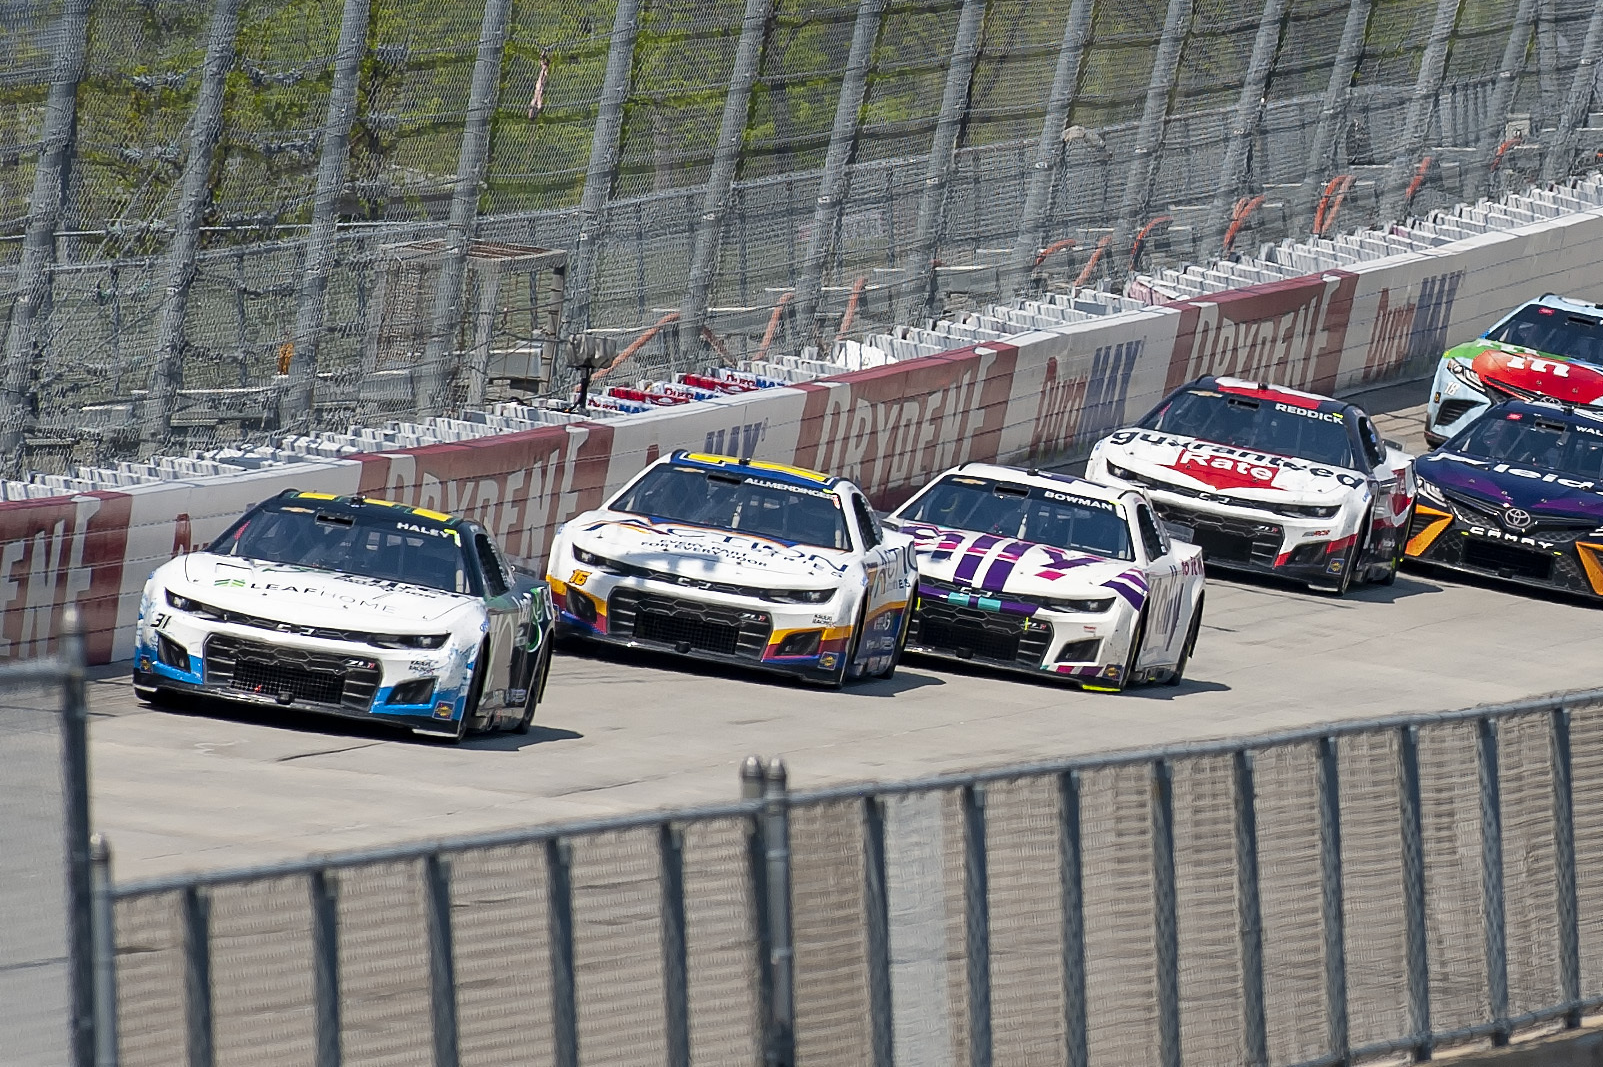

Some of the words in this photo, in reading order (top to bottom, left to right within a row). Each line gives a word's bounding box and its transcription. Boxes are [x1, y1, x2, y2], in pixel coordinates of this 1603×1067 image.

[1443, 381, 1461, 395] 18
[1275, 402, 1344, 425] REDDICK
[1109, 428, 1365, 490] guaranteed
[1181, 450, 1274, 481] Rate
[744, 477, 837, 501] ALLMENDINGER
[1044, 489, 1114, 511] BOWMAN
[396, 521, 450, 539] HALEY
[1469, 526, 1554, 550] CAMRY
[568, 568, 593, 586] 16
[151, 612, 172, 630] 31
